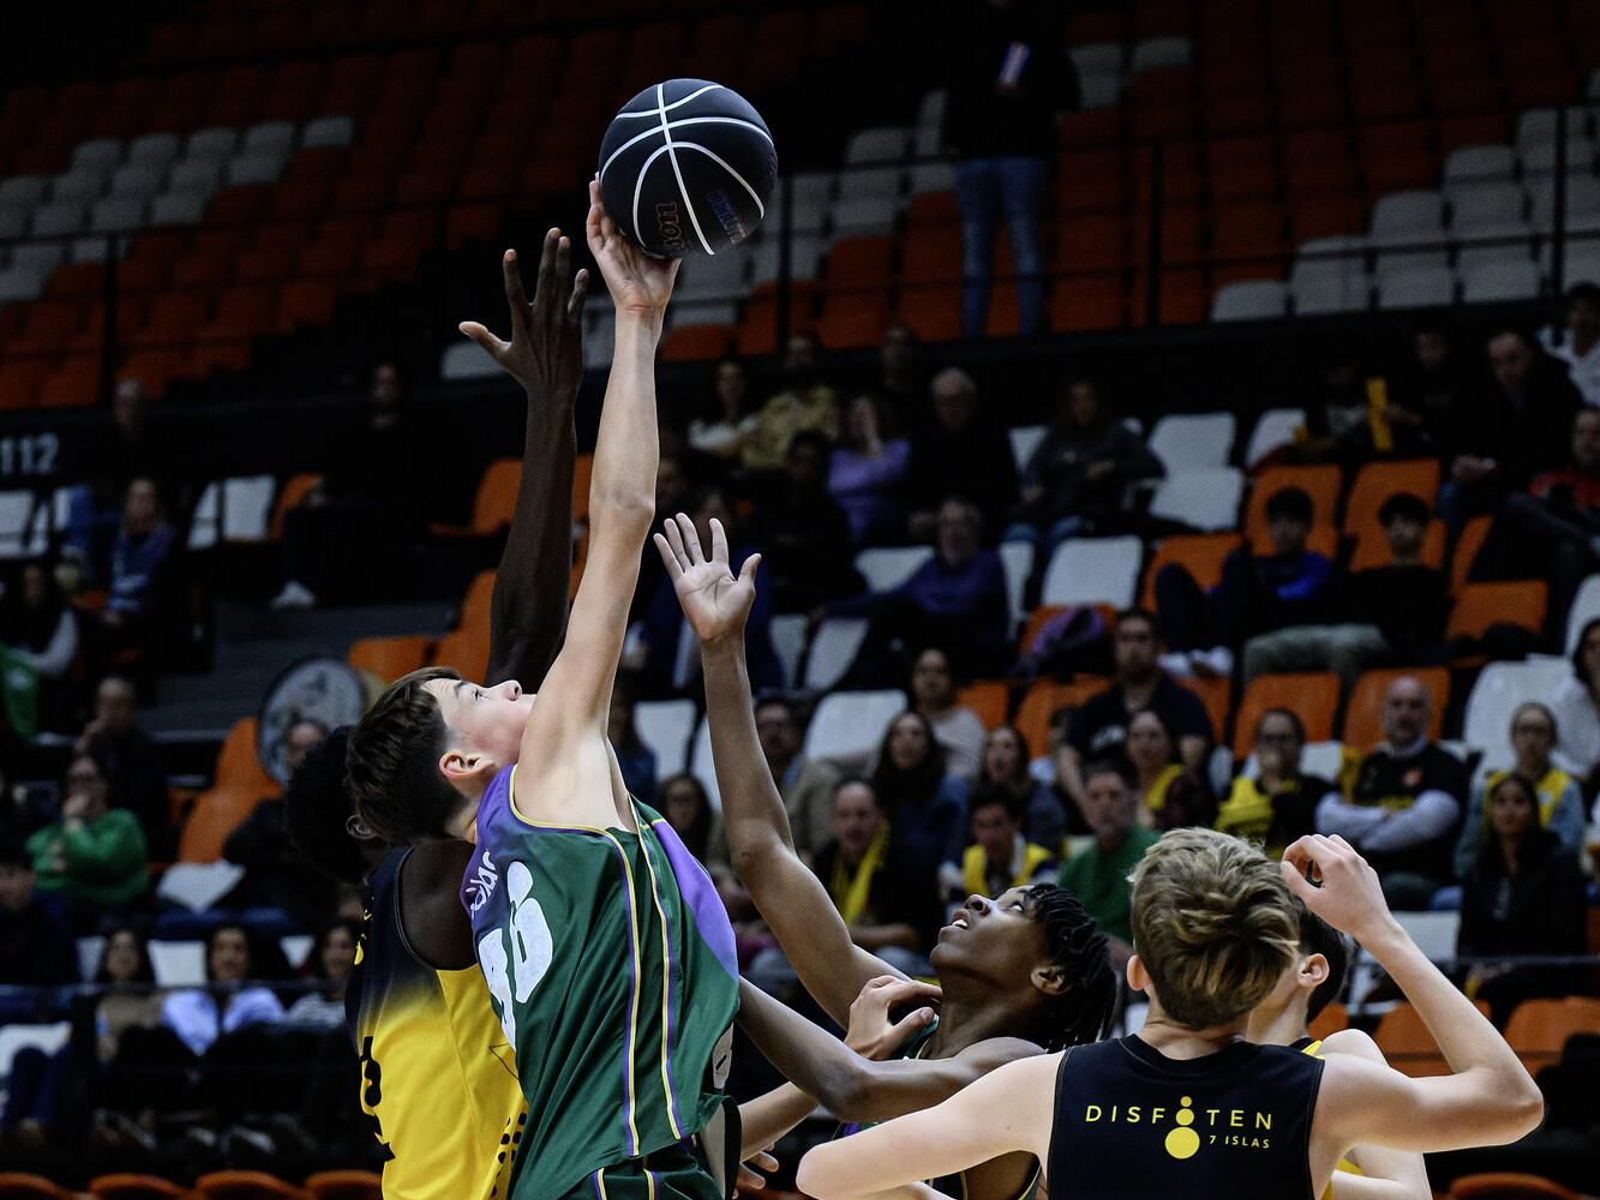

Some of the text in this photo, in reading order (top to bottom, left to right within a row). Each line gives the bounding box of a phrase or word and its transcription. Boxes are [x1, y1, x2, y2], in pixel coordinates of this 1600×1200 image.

[0, 433, 58, 475] 112
[1208, 1135, 1271, 1149] 7 ISLAS
